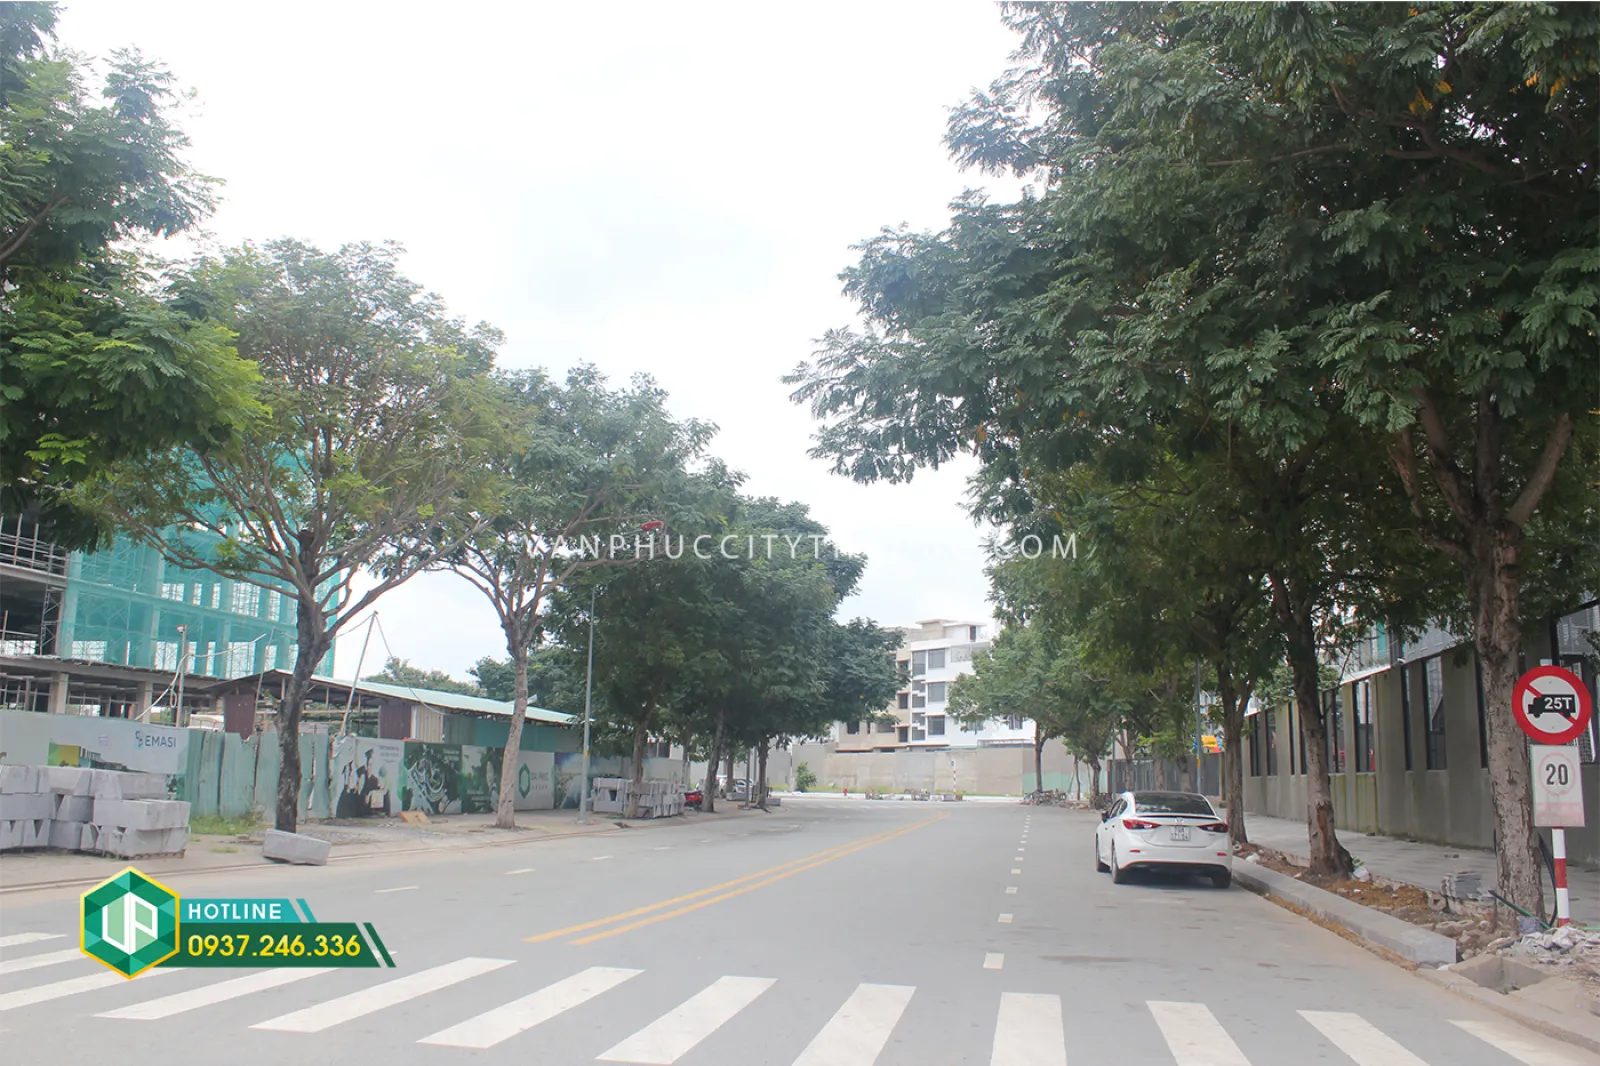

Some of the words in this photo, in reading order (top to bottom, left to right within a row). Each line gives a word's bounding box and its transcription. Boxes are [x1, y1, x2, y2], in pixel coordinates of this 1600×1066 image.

[1544, 697, 1572, 710] 25T
[145, 735, 176, 747] EMASI
[1545, 763, 1569, 786] 20
